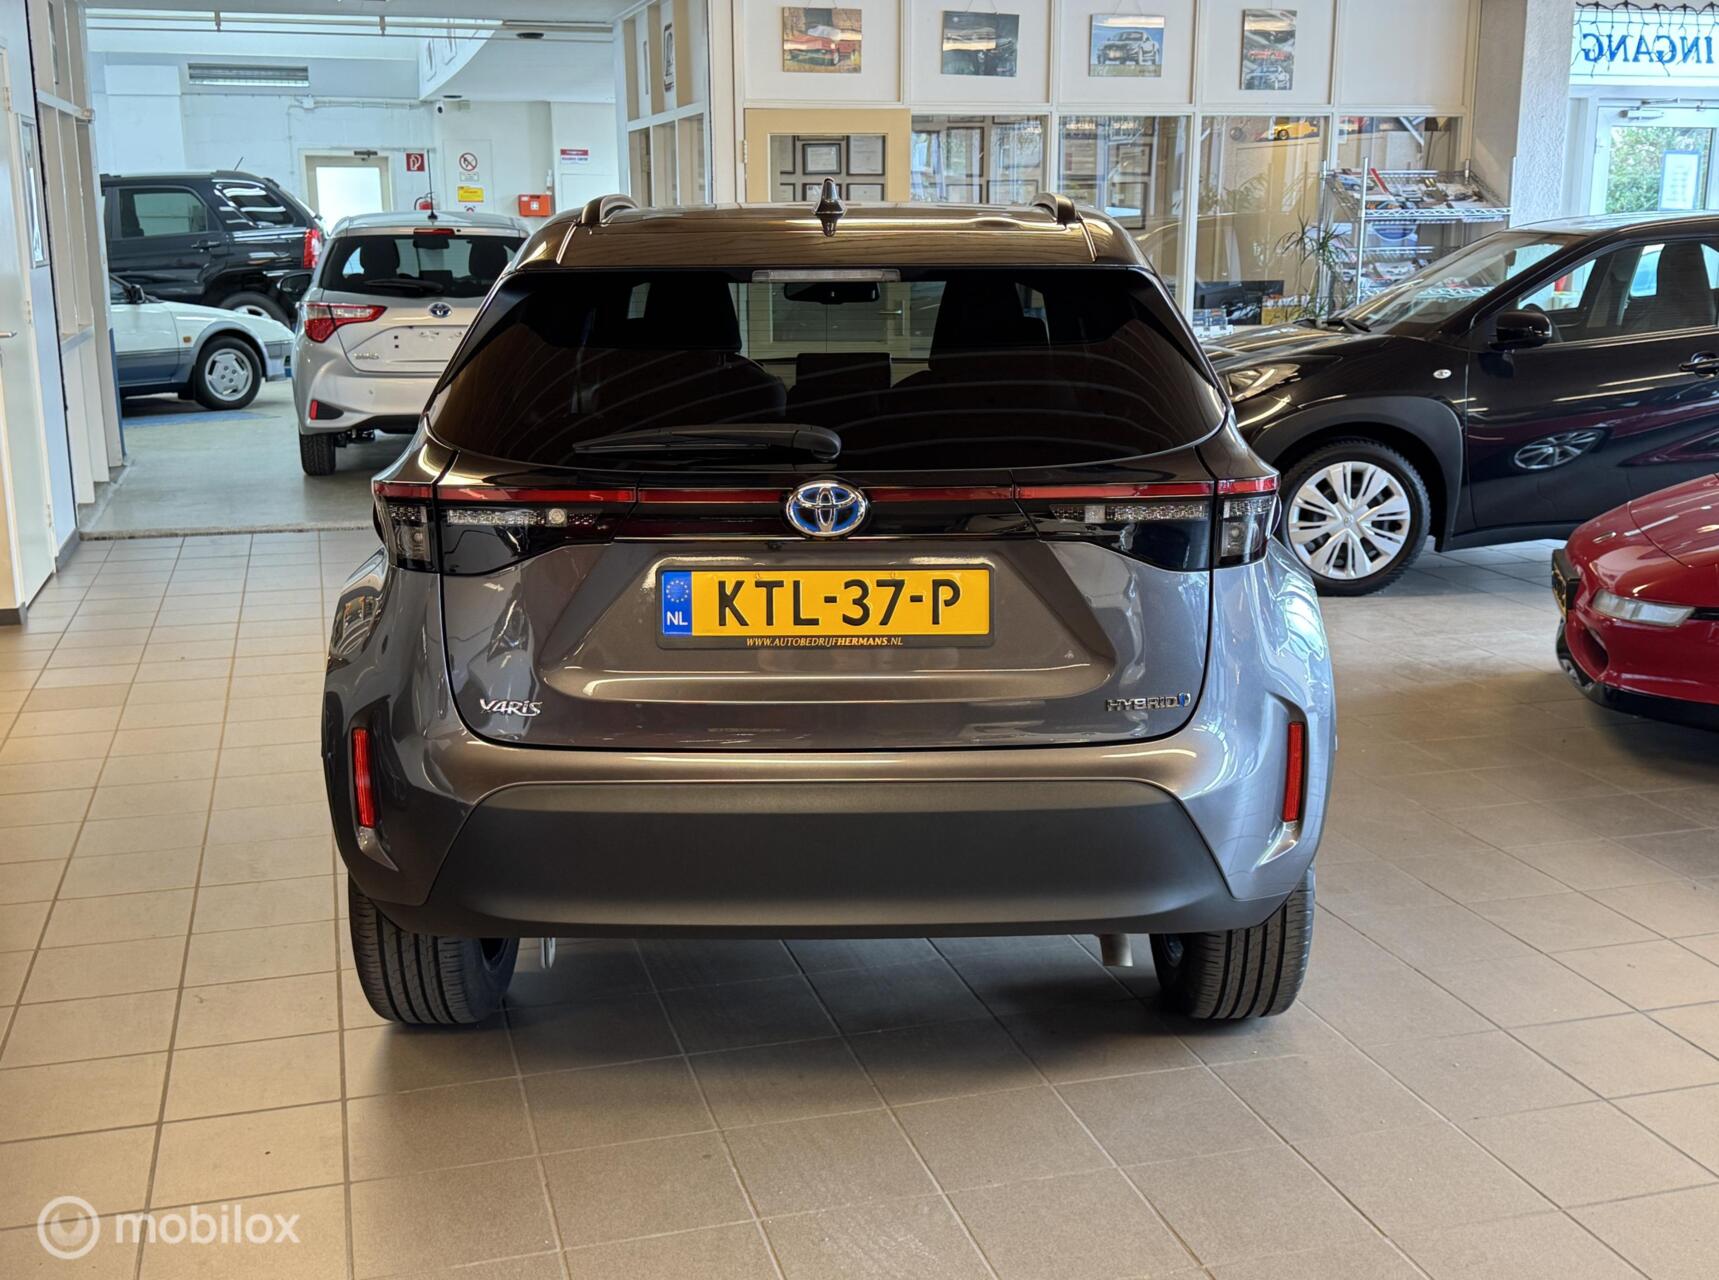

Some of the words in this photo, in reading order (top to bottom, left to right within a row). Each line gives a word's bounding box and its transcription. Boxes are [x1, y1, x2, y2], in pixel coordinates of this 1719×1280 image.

[717, 578, 962, 627] KTL-37-P
[666, 611, 688, 626] NL
[746, 637, 904, 648] WWW.AUTOBEDRIJFHERMANS.NL
[1106, 696, 1178, 712] HYBRID
